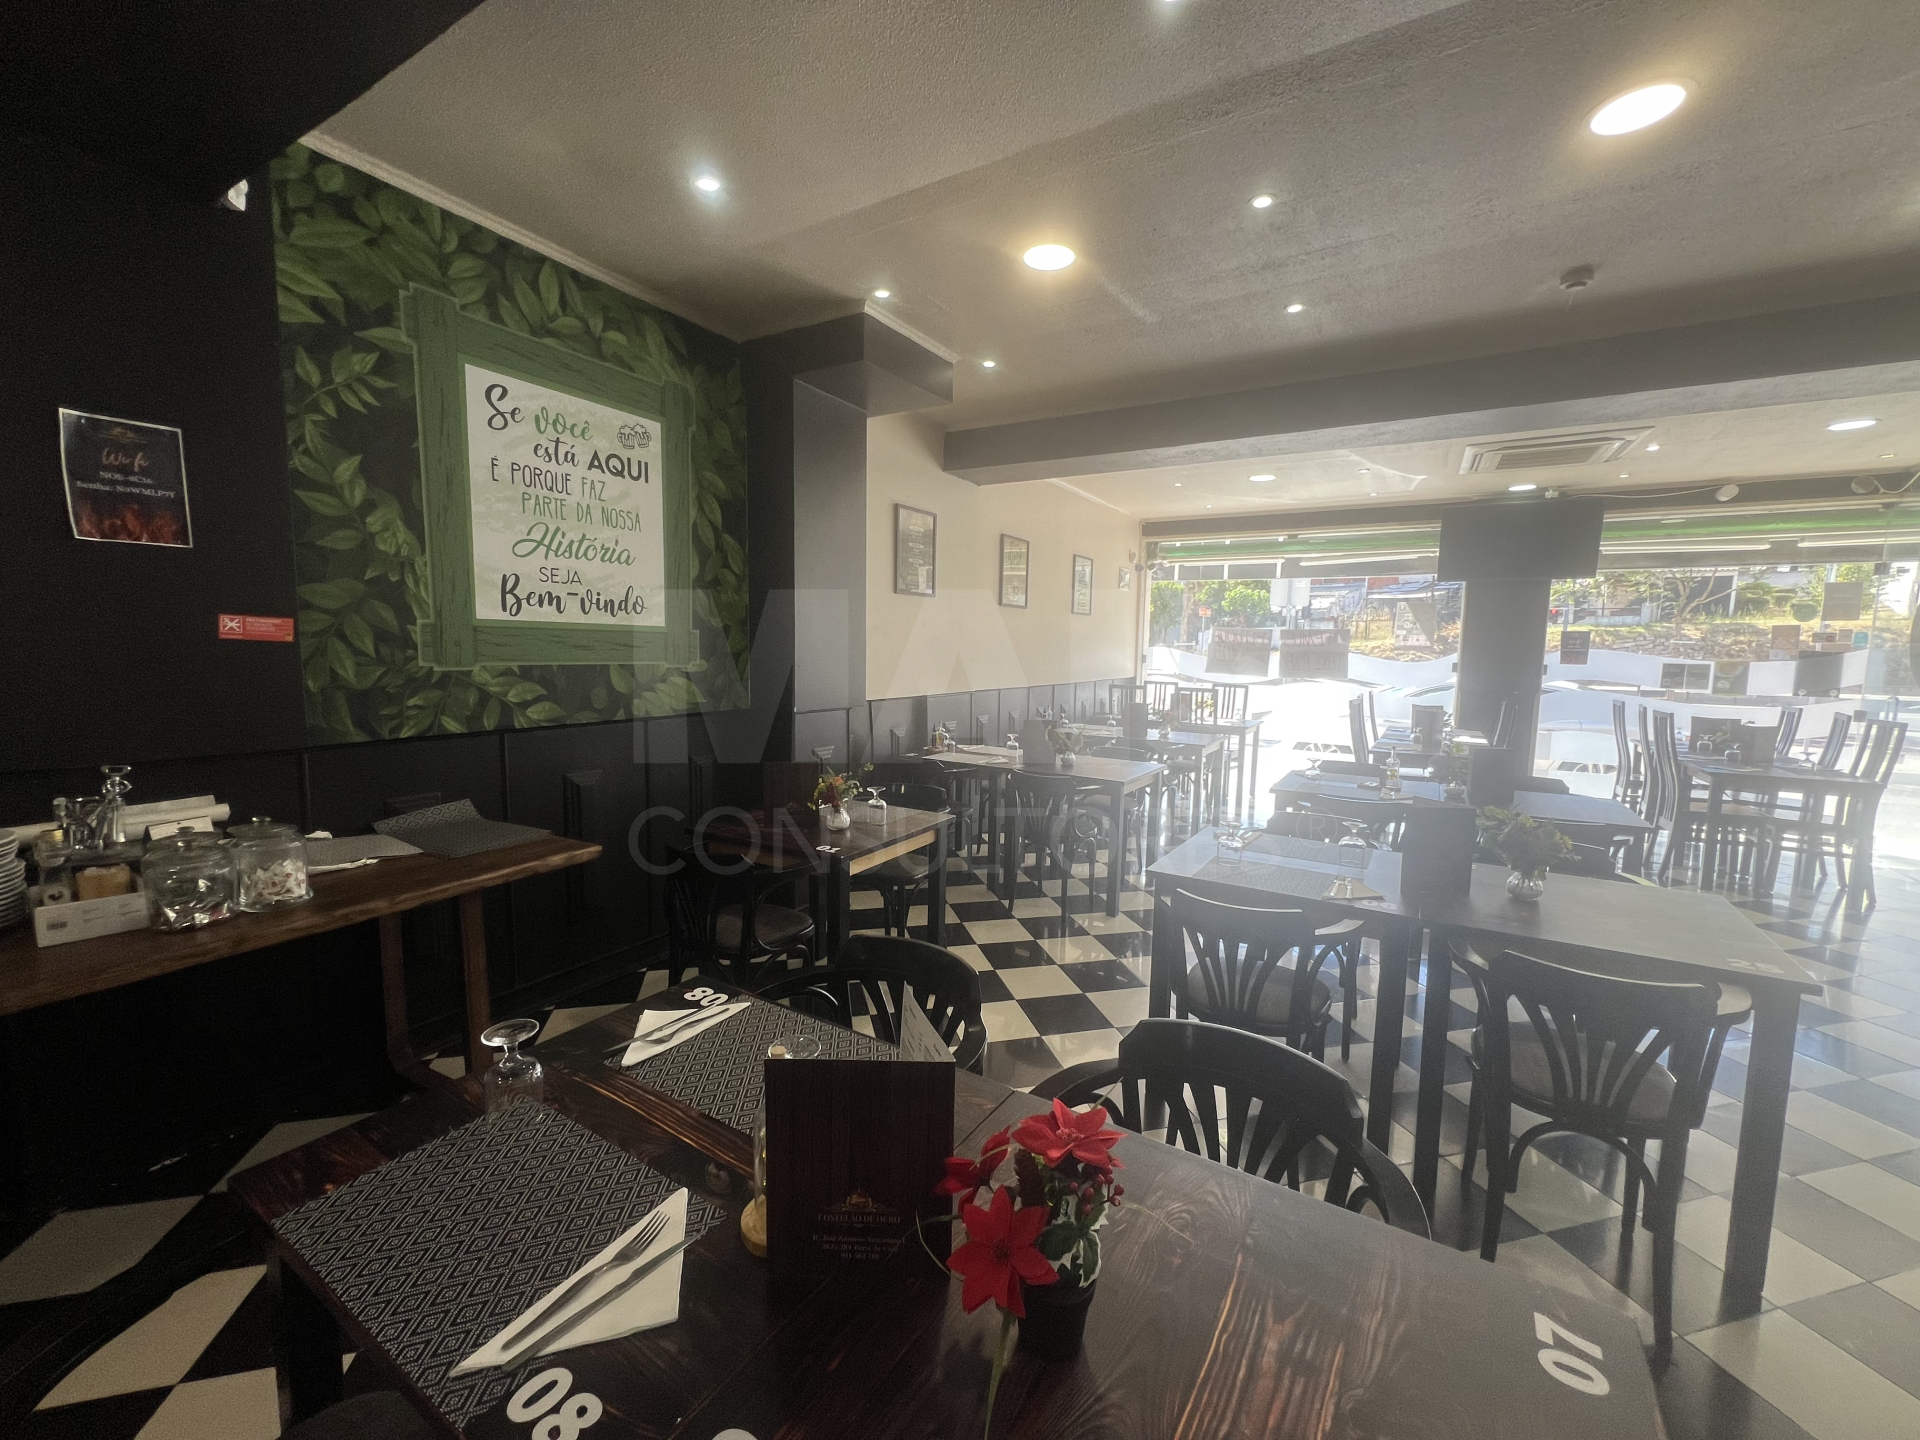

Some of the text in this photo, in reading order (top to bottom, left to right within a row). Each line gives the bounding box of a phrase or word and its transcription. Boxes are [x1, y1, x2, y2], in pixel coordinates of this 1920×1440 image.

[484, 383, 594, 441] Se você
[490, 455, 607, 502] É PORQUE FAZ
[533, 436, 650, 484] está AQUI
[521, 491, 642, 533] PARTE DA NOSSA
[511, 521, 636, 566] História
[500, 573, 648, 618] Bem-vindo
[538, 566, 583, 586] SEJA
[683, 986, 729, 1007] 08
[1533, 1311, 1610, 1396] 07
[506, 1366, 603, 1440] 08
